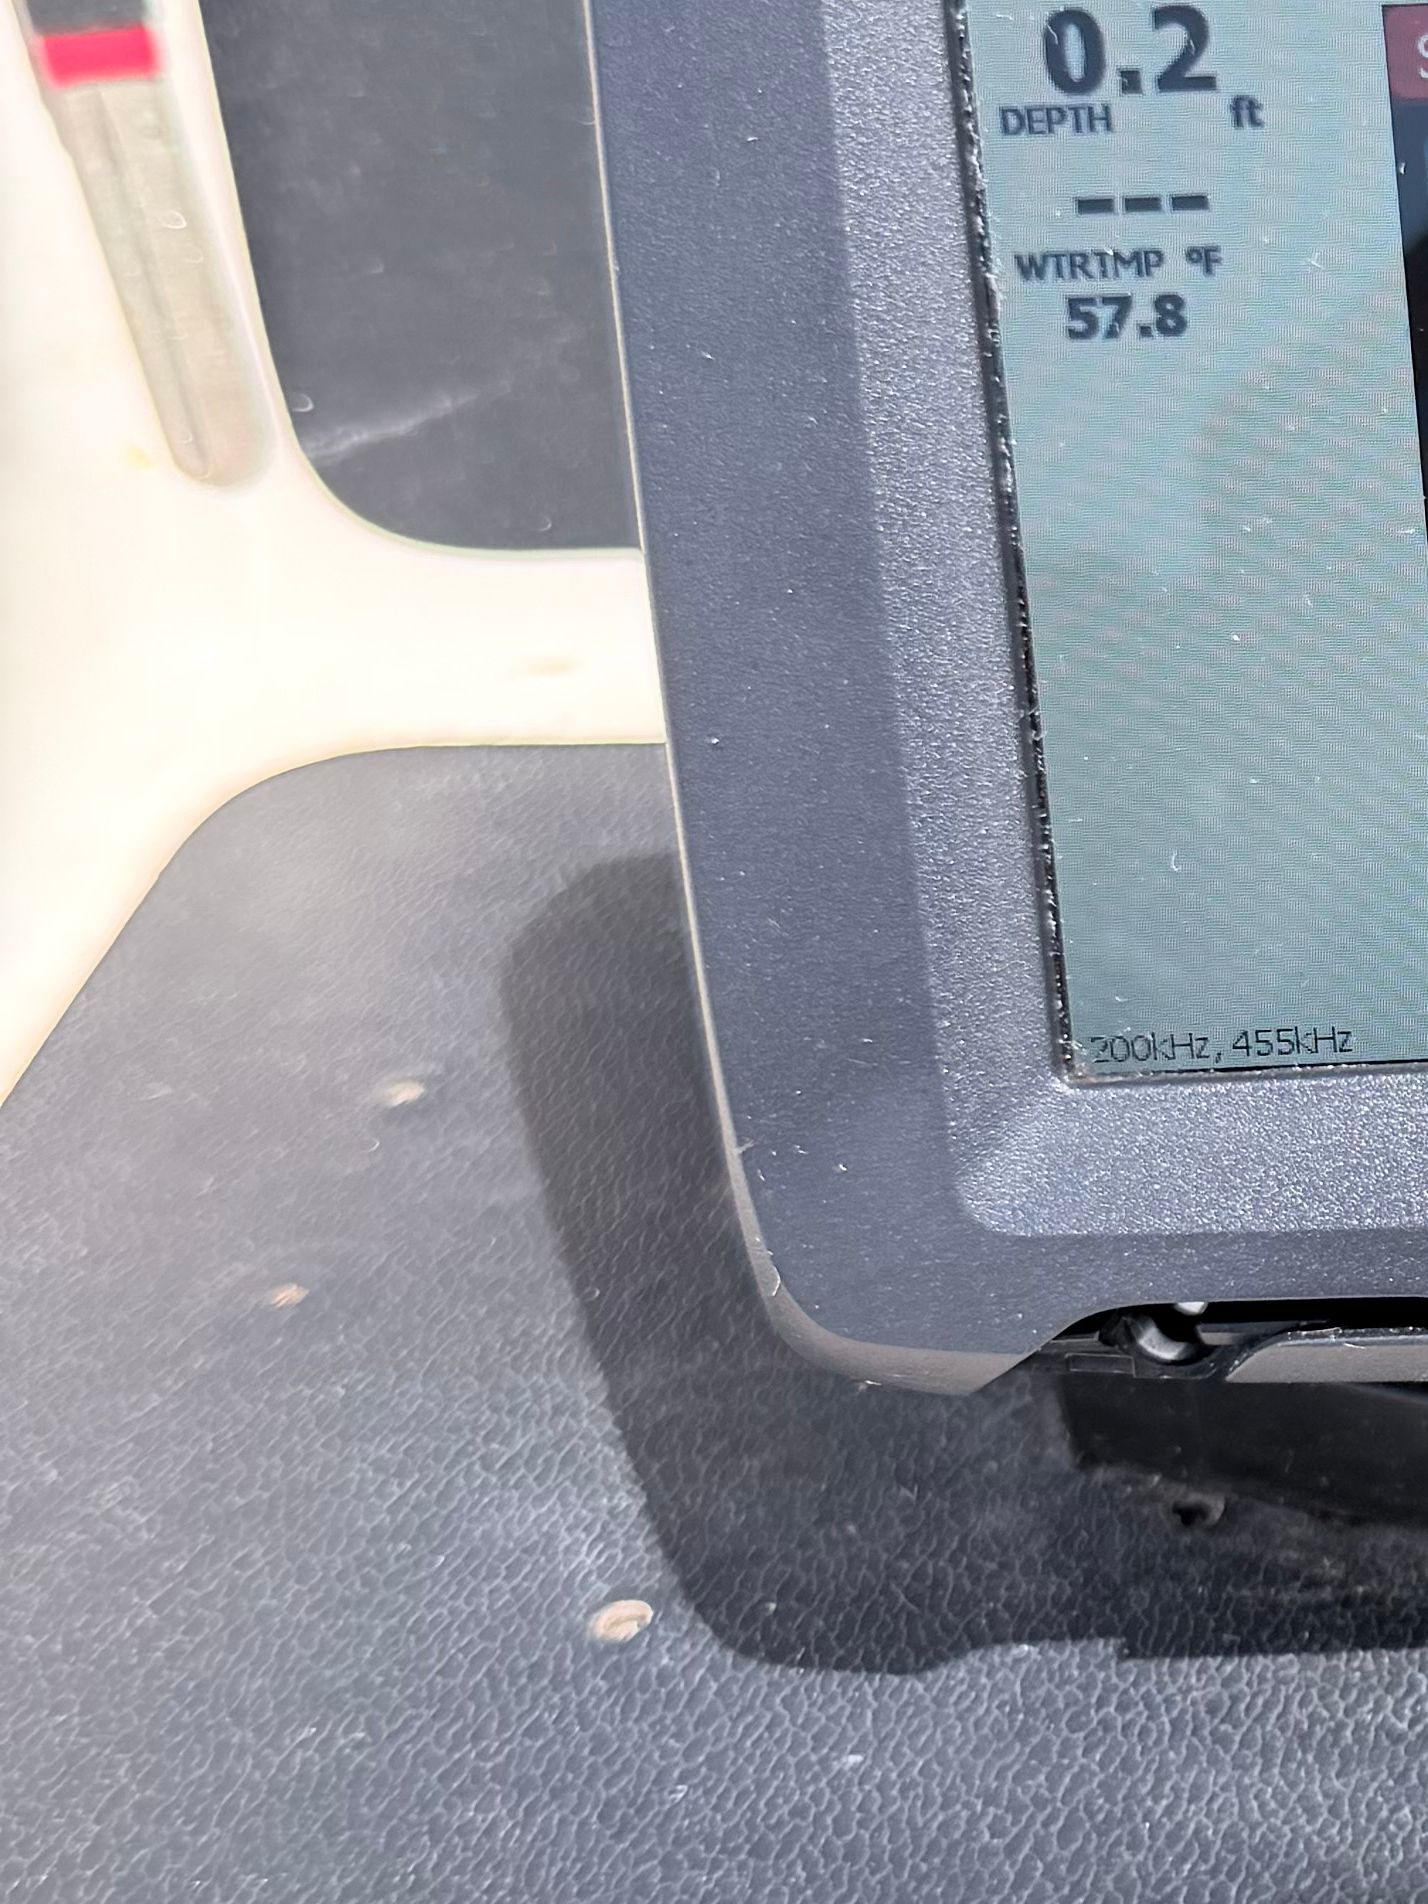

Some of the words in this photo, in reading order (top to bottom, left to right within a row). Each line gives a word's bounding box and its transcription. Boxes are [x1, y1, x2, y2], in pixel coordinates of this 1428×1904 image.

[1043, 3, 1218, 96] 0.2
[1000, 104, 1114, 136] DEPTH
[1229, 95, 1266, 130] ft
[1014, 248, 1165, 282] WTRTMP
[1066, 293, 1188, 341] 57.8
[1232, 1025, 1354, 1057] 455kHz
